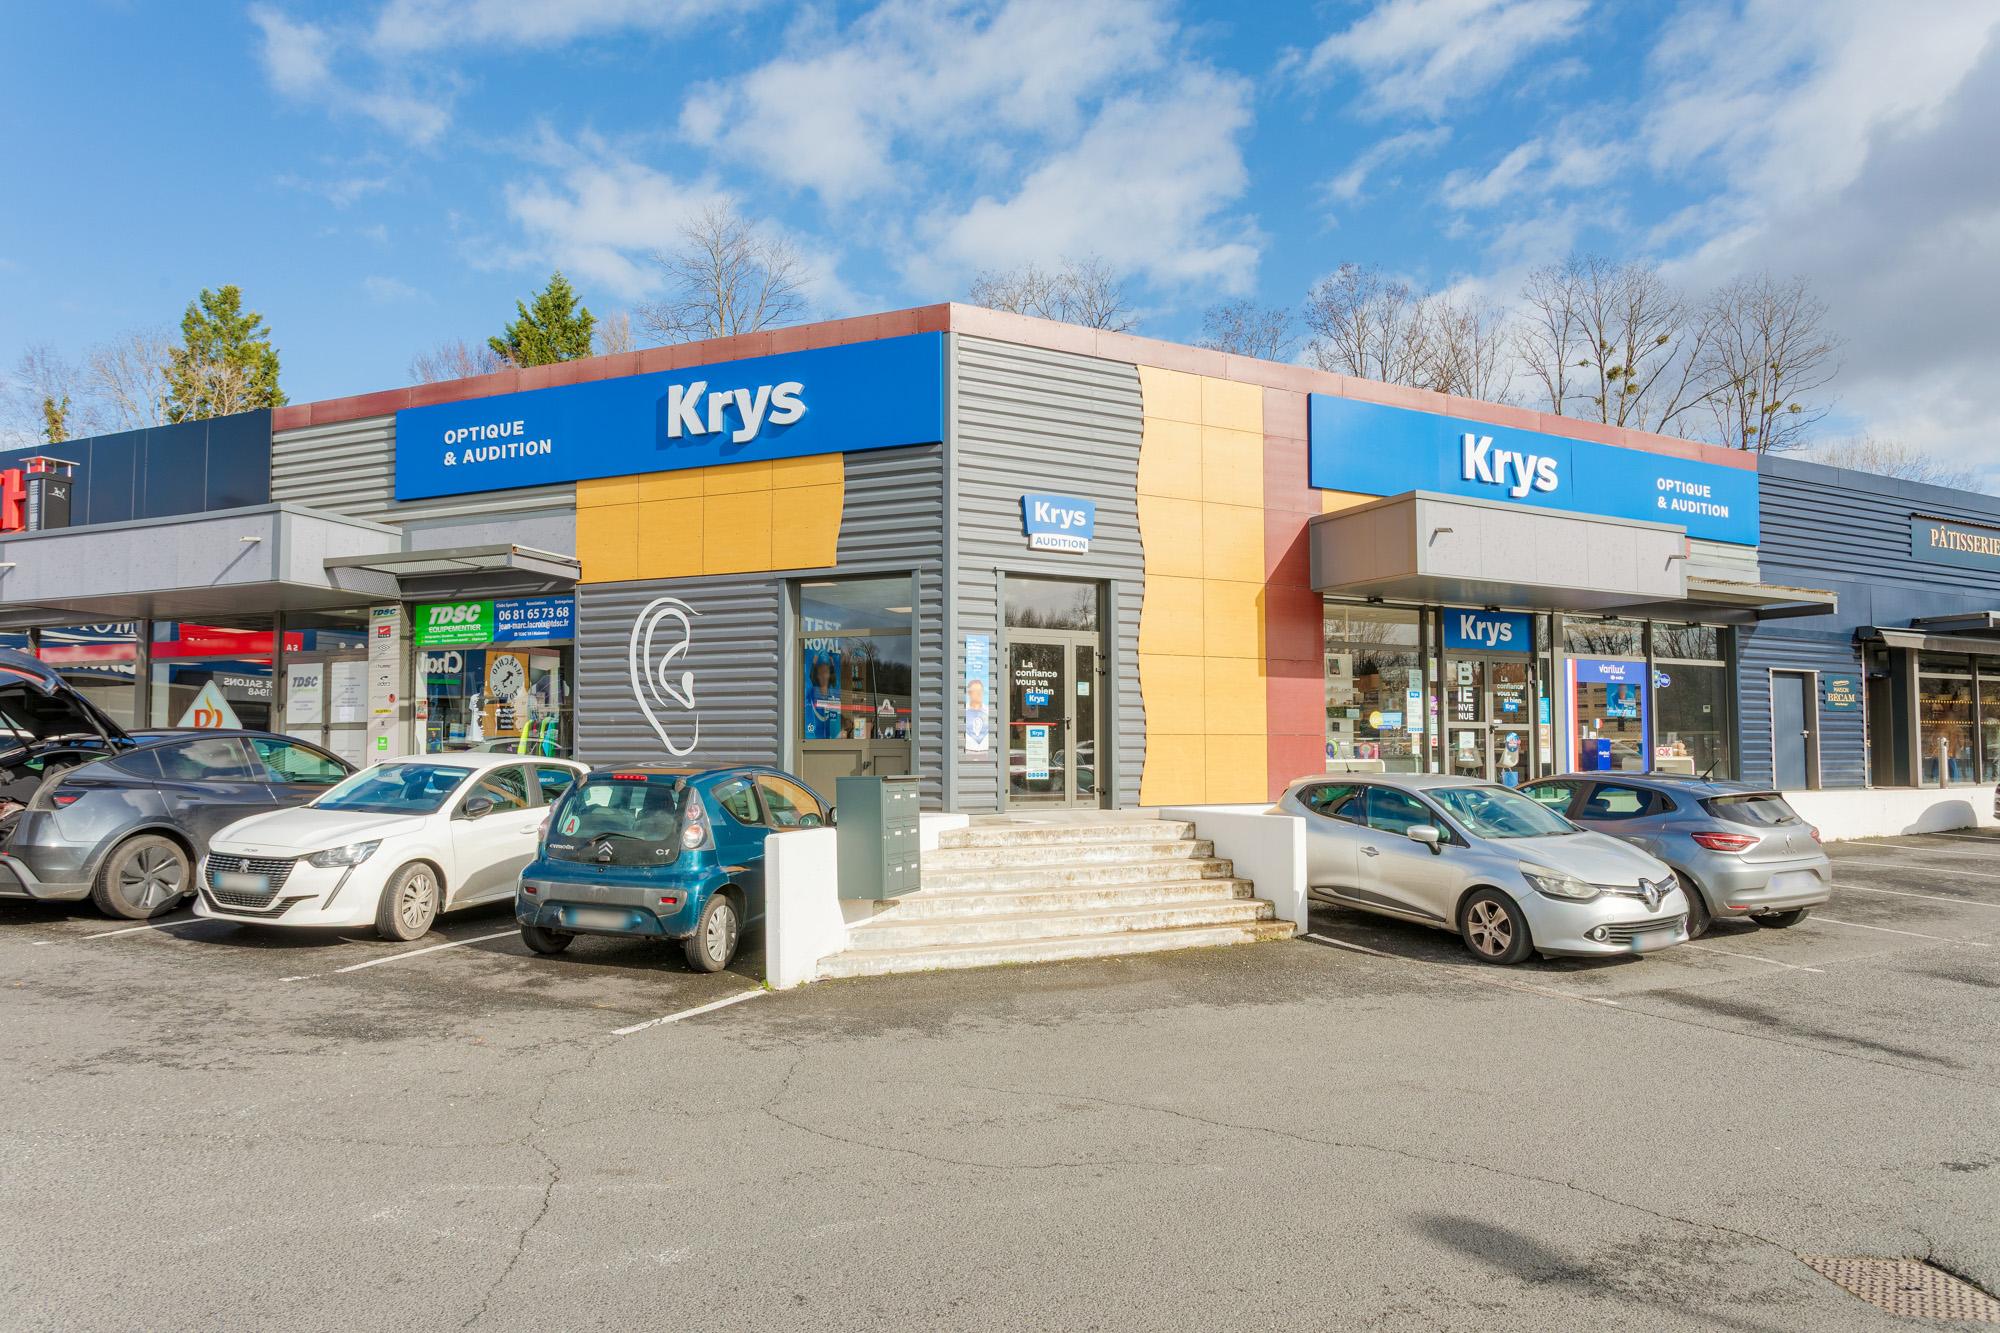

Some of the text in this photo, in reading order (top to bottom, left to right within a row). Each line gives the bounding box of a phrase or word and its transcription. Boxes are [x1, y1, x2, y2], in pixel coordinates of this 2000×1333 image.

[667, 381, 808, 444] Krys
[444, 421, 525, 445] OPTIQUE
[443, 439, 552, 466] & AUDITION
[1462, 433, 1558, 498] Krys
[1657, 478, 1711, 498] OPTIQUE
[1035, 501, 1086, 529] Krys
[1657, 497, 1729, 518] & AUDITION
[1035, 537, 1086, 549] AUDITION
[1930, 525, 2000, 556] PÂTISSERIE
[372, 608, 396, 616] TDSC
[429, 604, 481, 624] TDSC
[498, 607, 569, 621] 06 81 65 73 68
[429, 624, 481, 633] EQUIPEMENTIER
[1460, 614, 1513, 646] Krys
[805, 638, 841, 654] ROYAL
[1022, 660, 1033, 668] La
[292, 676, 318, 687] TDSC
[1015, 670, 1058, 678] confiance
[1458, 663, 1473, 685] B
[1026, 687, 1054, 695] si bien
[1458, 687, 1474, 702] IE
[1828, 693, 1856, 702] BECAM
[1029, 695, 1045, 703] Krys
[1458, 704, 1474, 712] NVE
[1458, 712, 1474, 720] NUE
[565, 818, 576, 833] A
